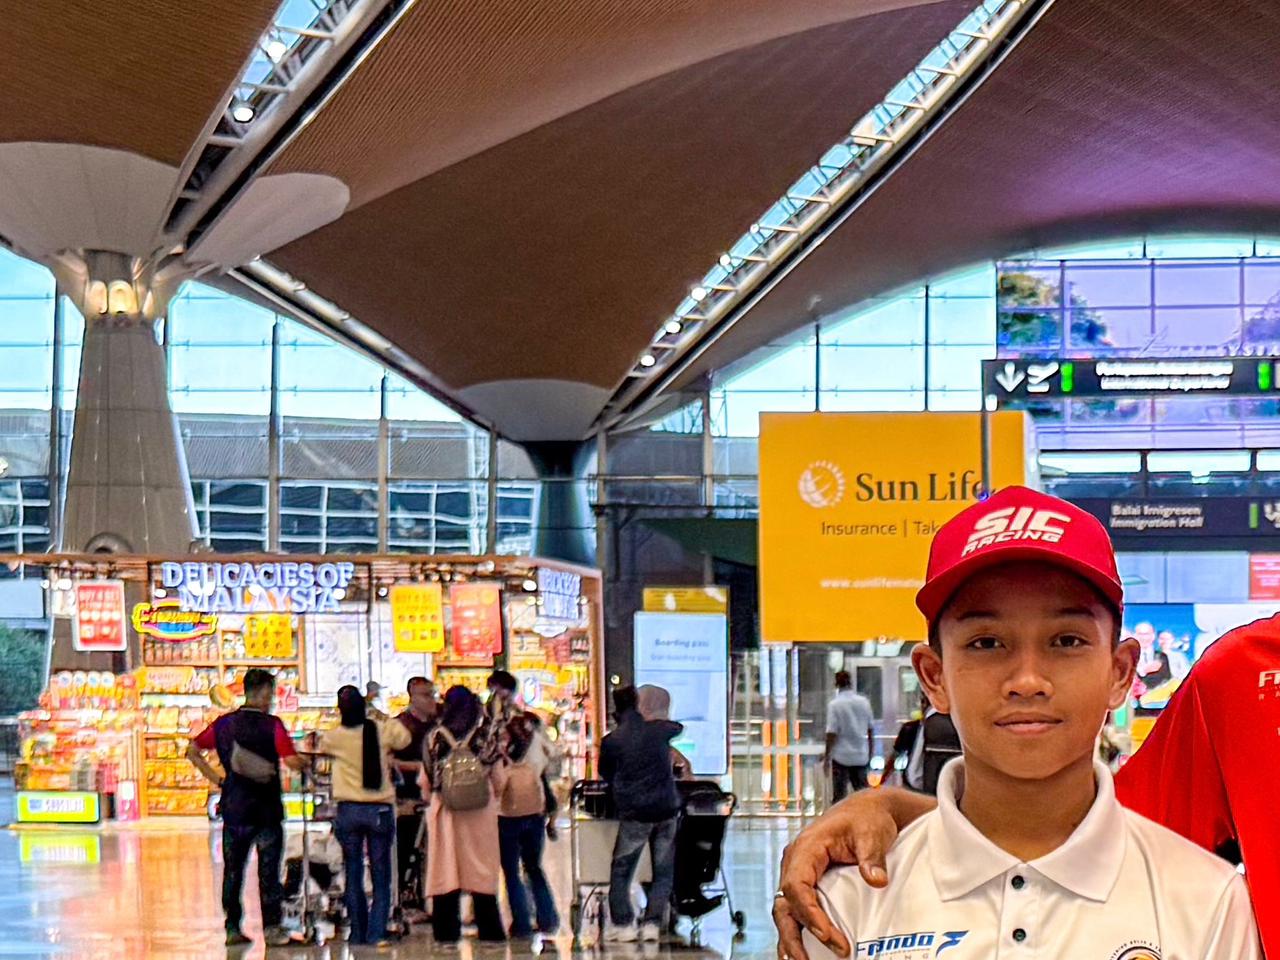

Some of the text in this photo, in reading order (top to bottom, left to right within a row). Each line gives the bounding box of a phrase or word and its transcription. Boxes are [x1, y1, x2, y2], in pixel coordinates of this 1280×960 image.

[855, 473, 920, 502] Sun
[821, 521, 898, 536] Insurance
[914, 521, 938, 536] Tak
[967, 507, 1072, 545] SIC
[961, 530, 1062, 558] RACING
[162, 562, 354, 589] DELICACIES OF
[179, 586, 342, 613] MALAYSIA
